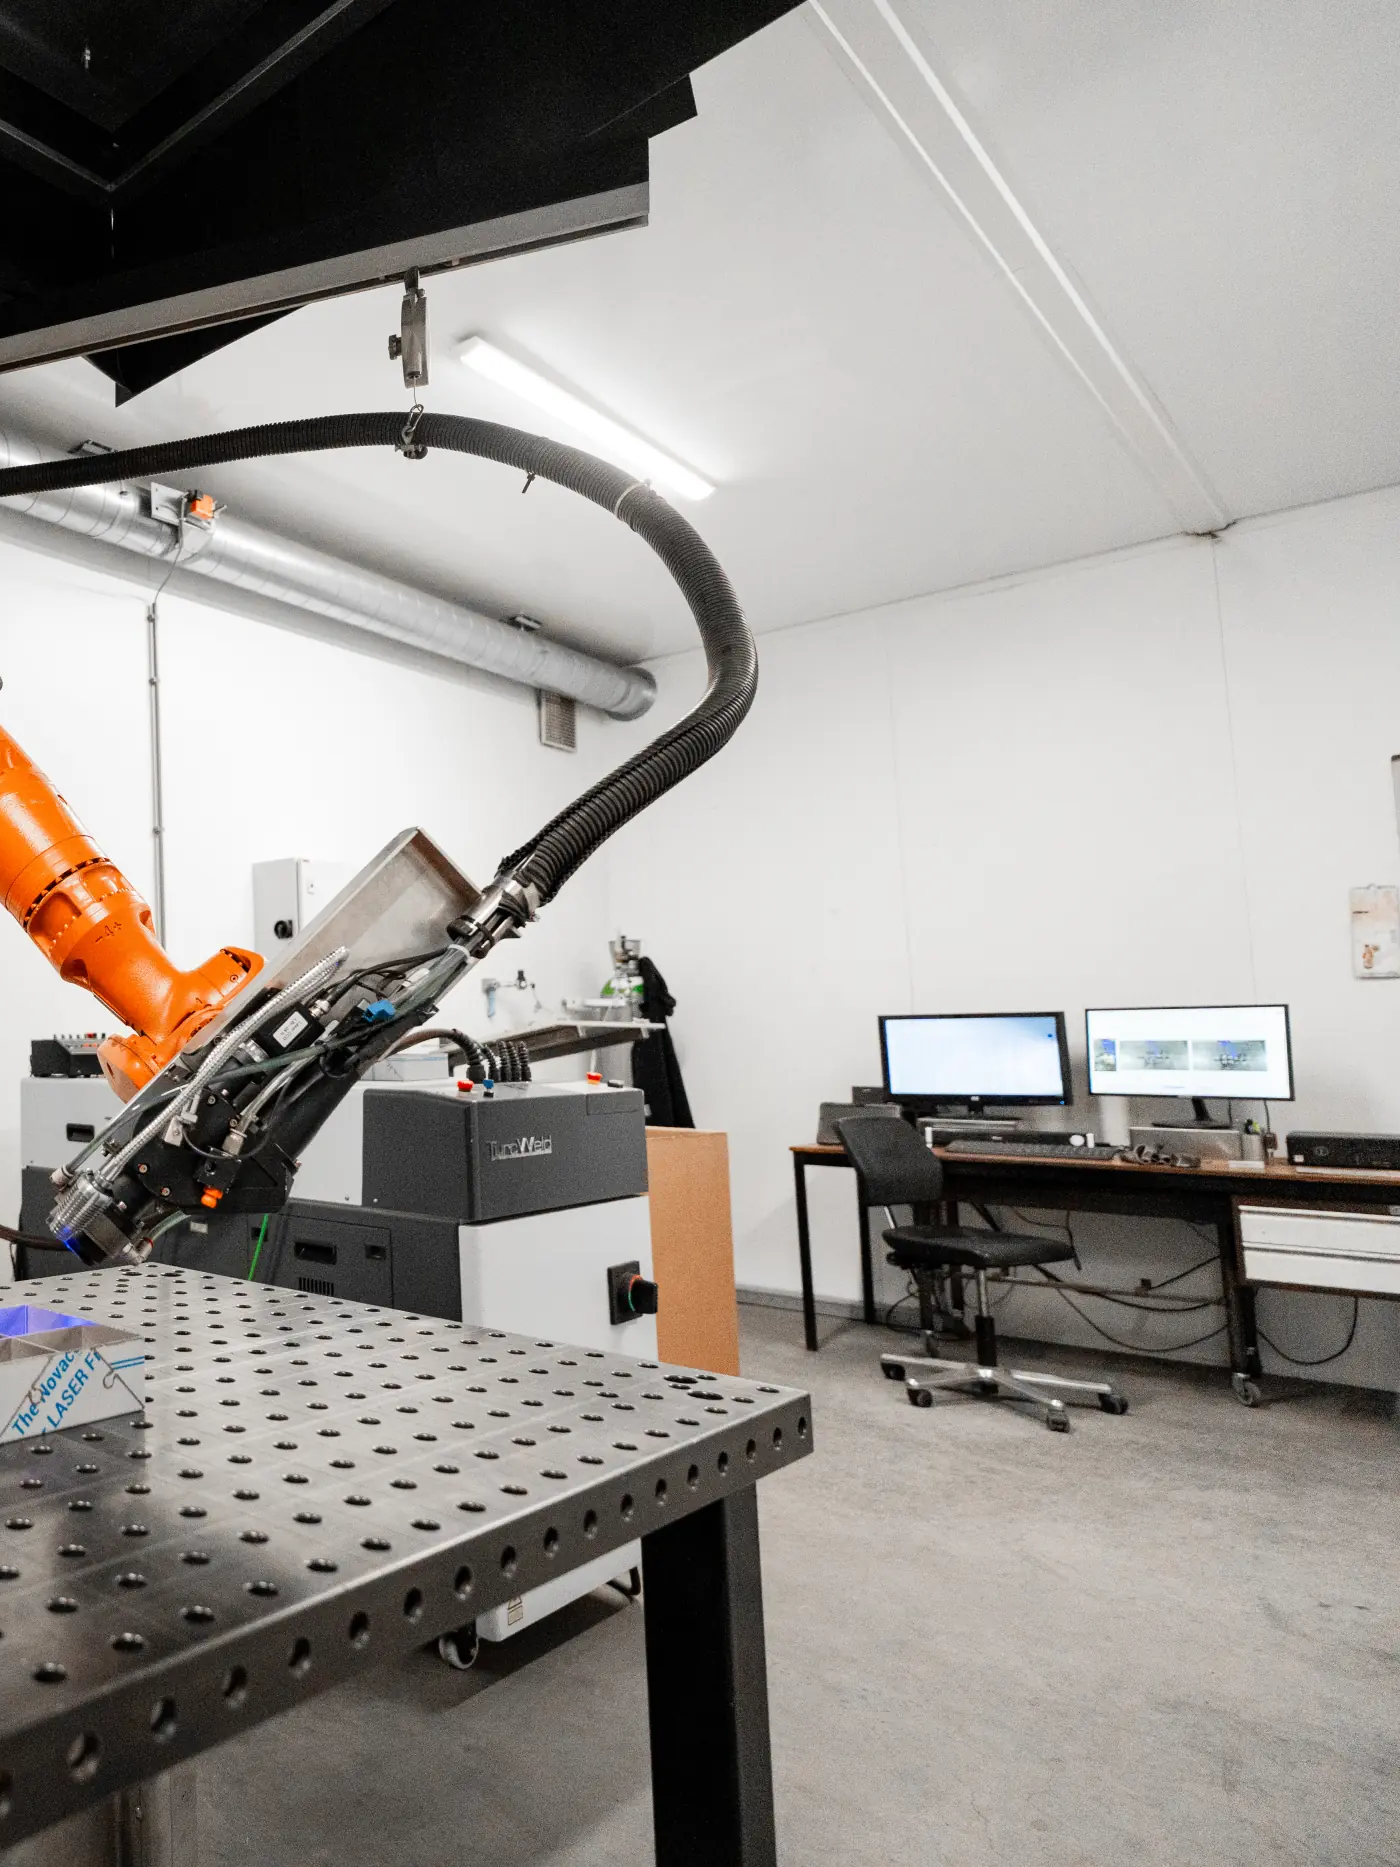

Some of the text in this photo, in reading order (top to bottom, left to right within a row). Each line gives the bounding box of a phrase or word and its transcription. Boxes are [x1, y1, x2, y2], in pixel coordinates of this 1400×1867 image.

[11, 1349, 81, 1435] The Novac
[46, 1368, 89, 1428] LASER
